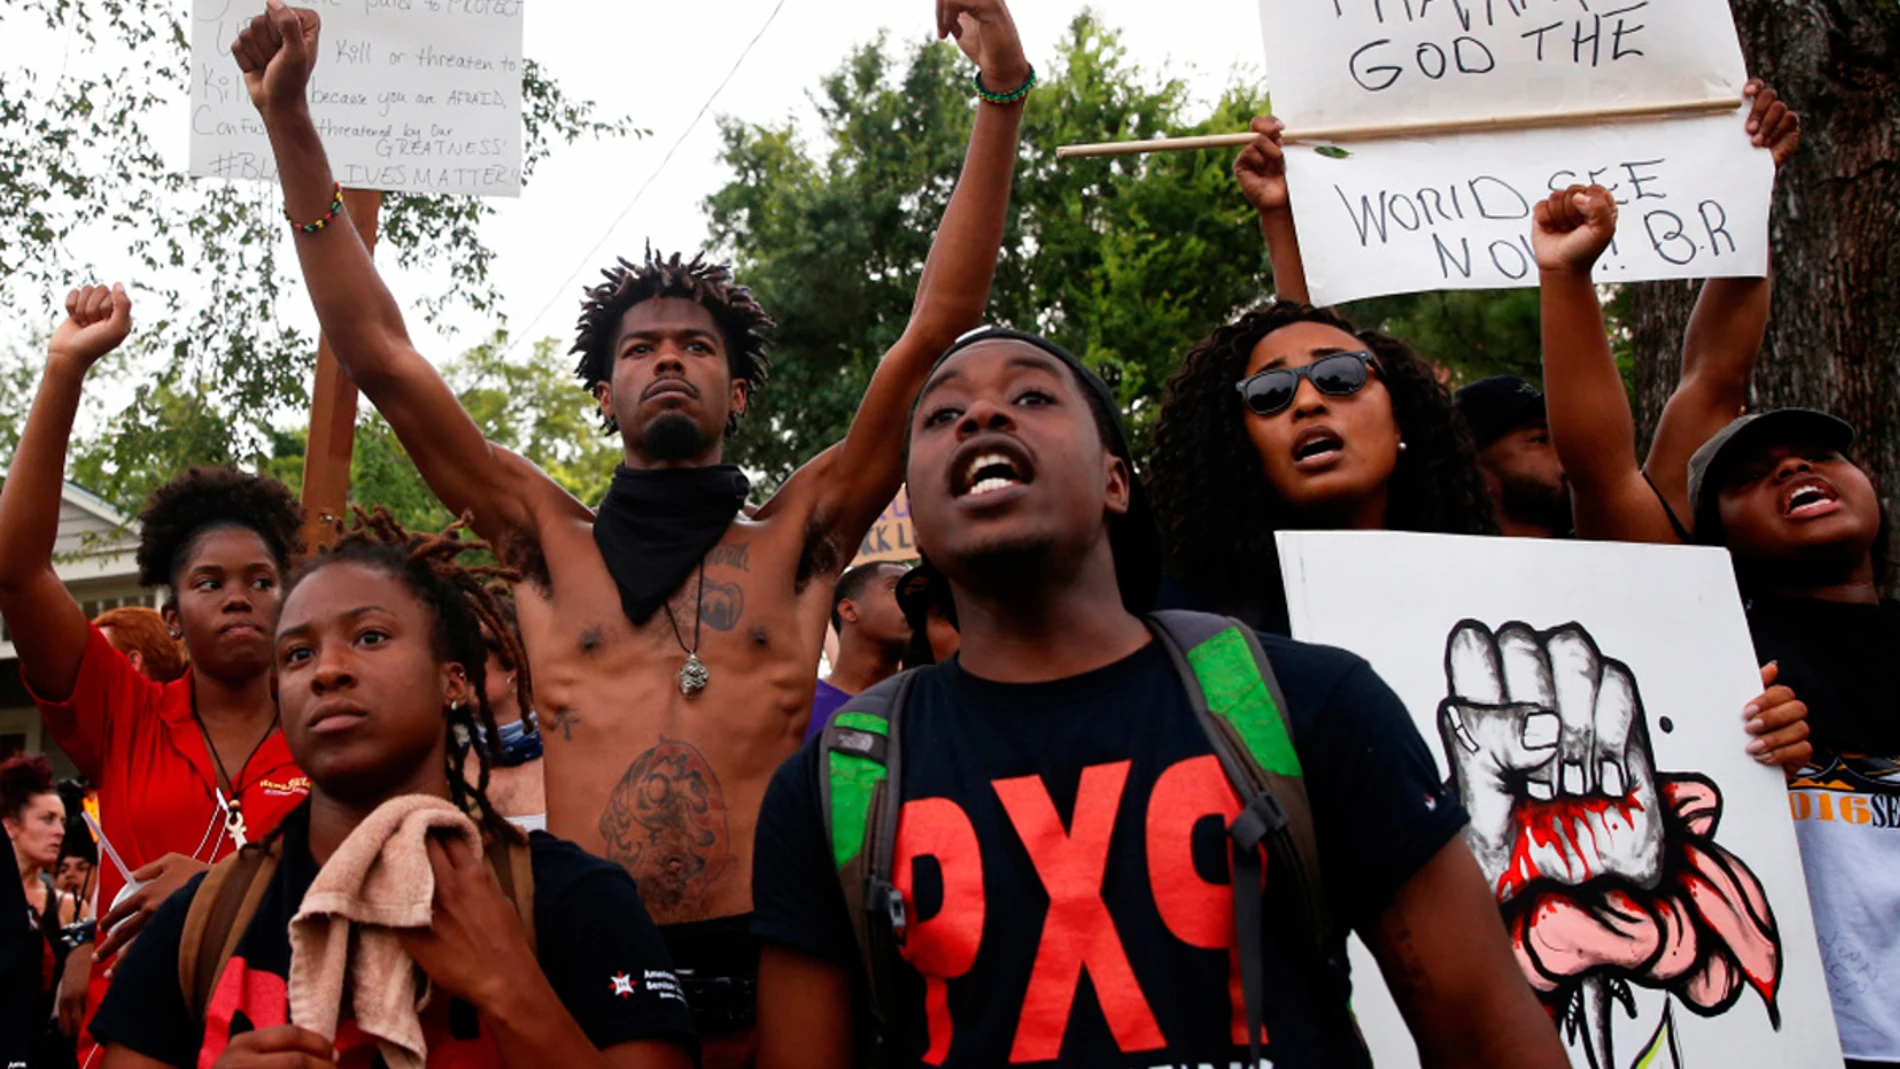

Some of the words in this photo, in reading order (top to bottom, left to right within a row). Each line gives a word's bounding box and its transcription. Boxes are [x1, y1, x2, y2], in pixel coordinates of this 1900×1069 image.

[416, 45, 492, 71] threaten
[501, 55, 516, 71] to
[1350, 36, 1494, 91] GOD
[1521, 1, 1649, 67] THE
[378, 91, 405, 117] you
